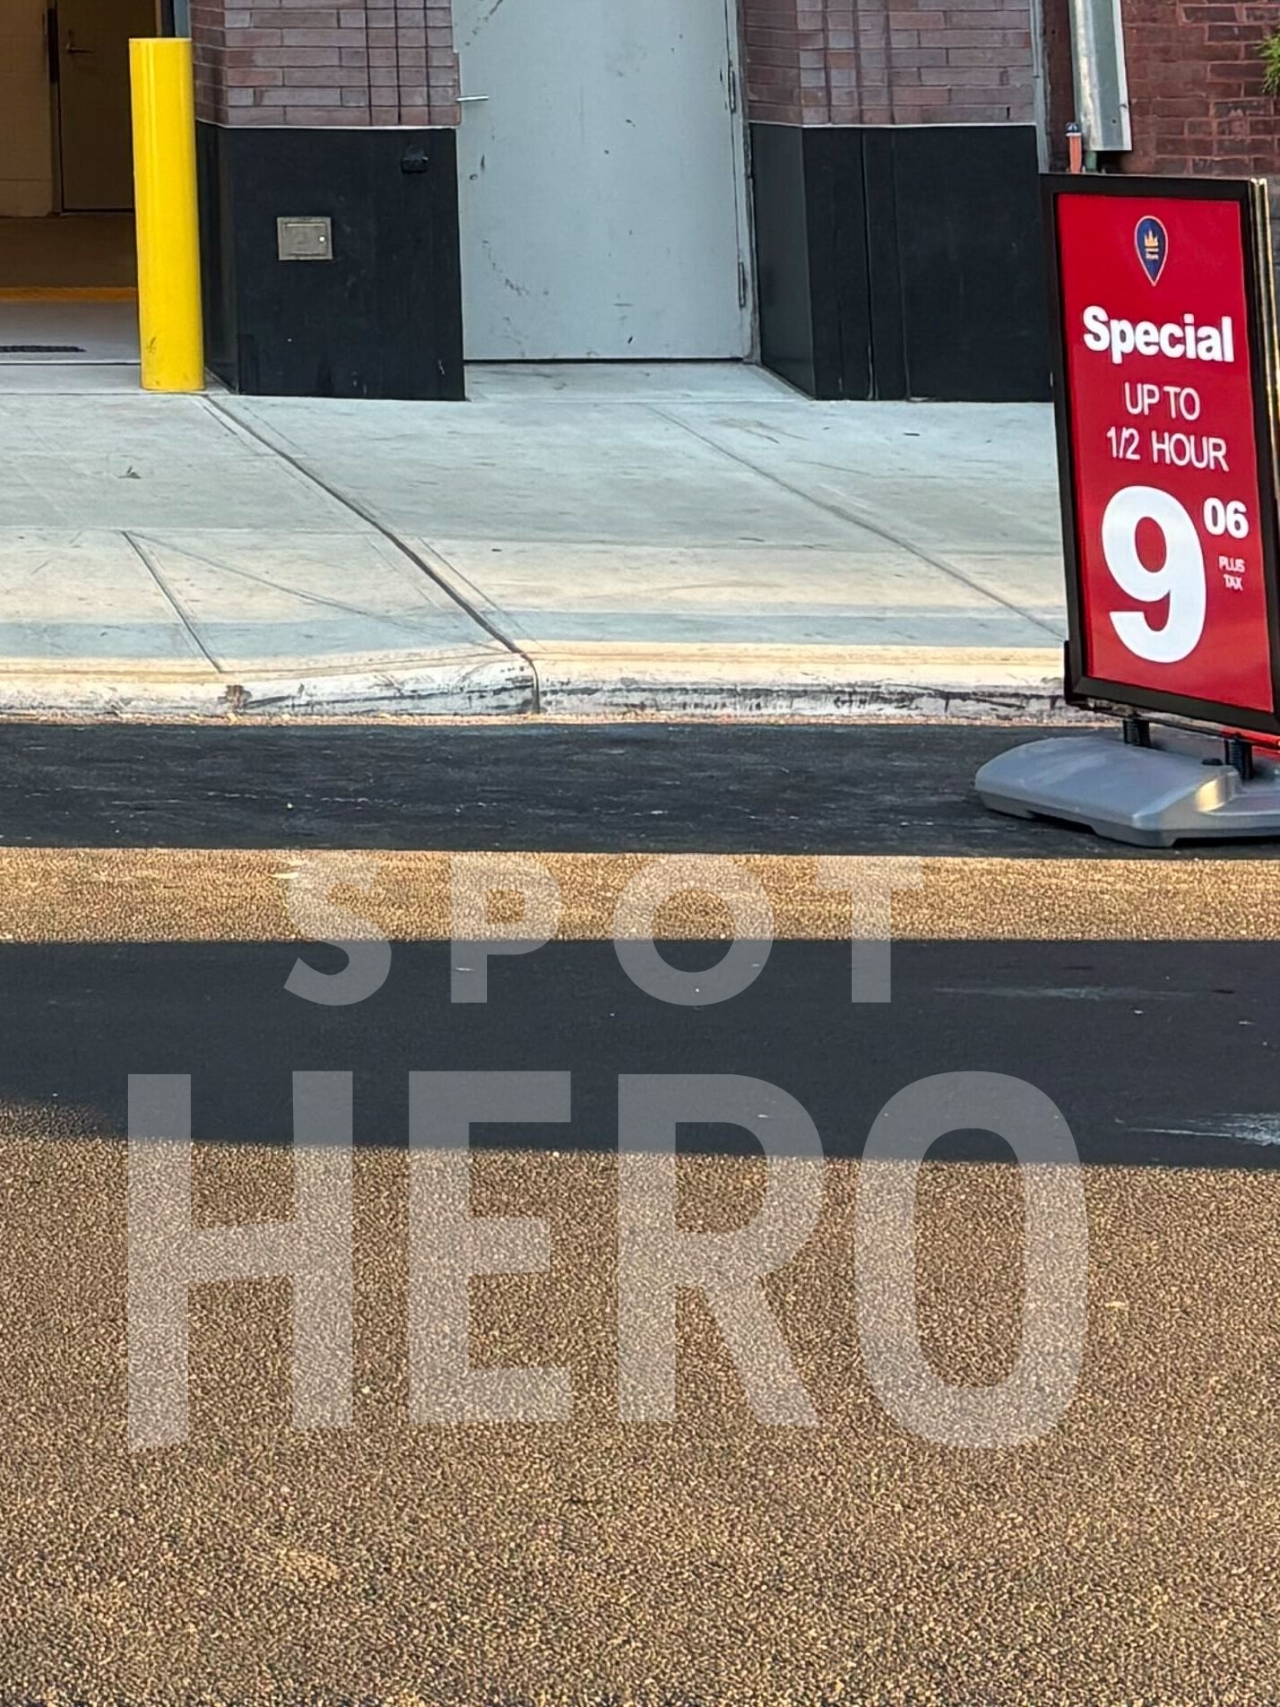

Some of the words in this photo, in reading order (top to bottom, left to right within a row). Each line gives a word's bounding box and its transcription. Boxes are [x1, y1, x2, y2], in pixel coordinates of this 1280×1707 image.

[1082, 305, 1235, 365] Special
[1124, 381, 1160, 416] UP
[1163, 385, 1201, 421] TO
[1106, 426, 1141, 461] 1/2
[1151, 430, 1230, 472] HOUR
[1101, 485, 1207, 664] 9
[1203, 496, 1250, 539] 06
[1218, 555, 1246, 573] PLUS
[1223, 574, 1244, 591] TAX
